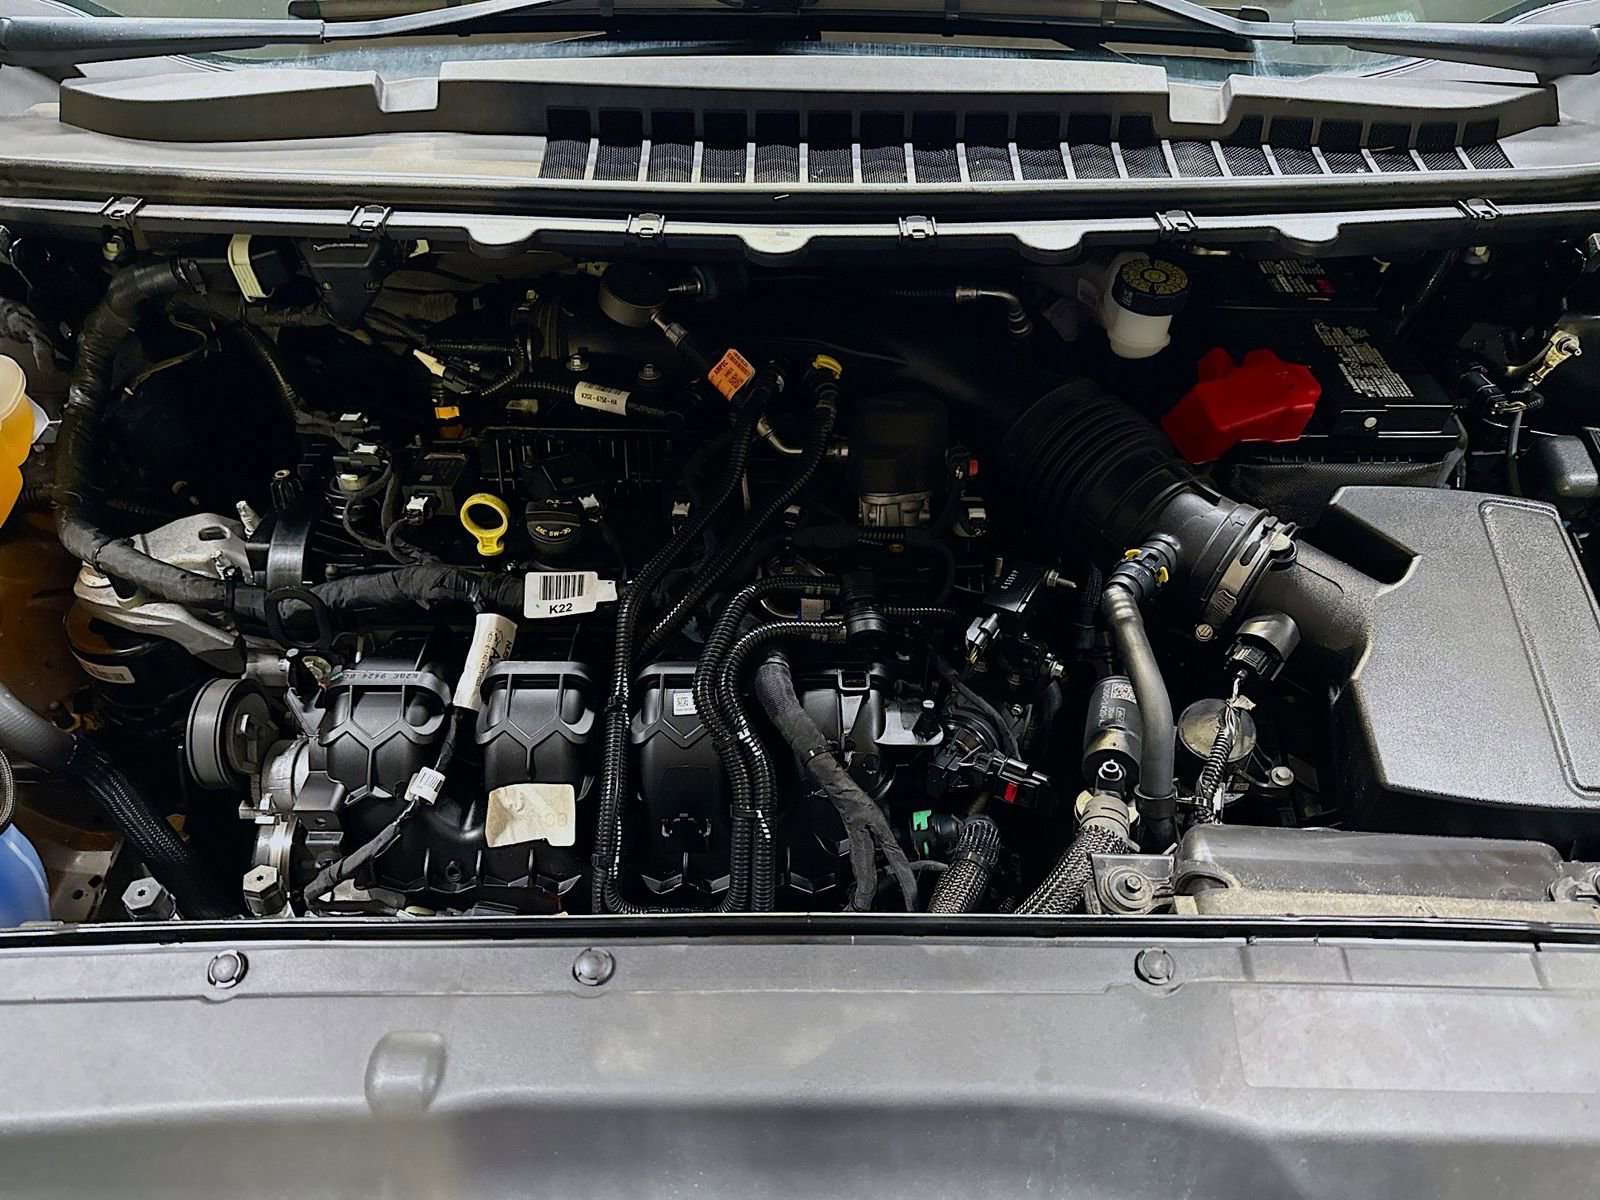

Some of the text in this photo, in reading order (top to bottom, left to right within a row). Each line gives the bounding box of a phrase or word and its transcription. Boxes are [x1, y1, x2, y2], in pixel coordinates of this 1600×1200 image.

[548, 527, 572, 537] 5W-30
[549, 602, 573, 615] K22
[362, 672, 387, 680] 9424
